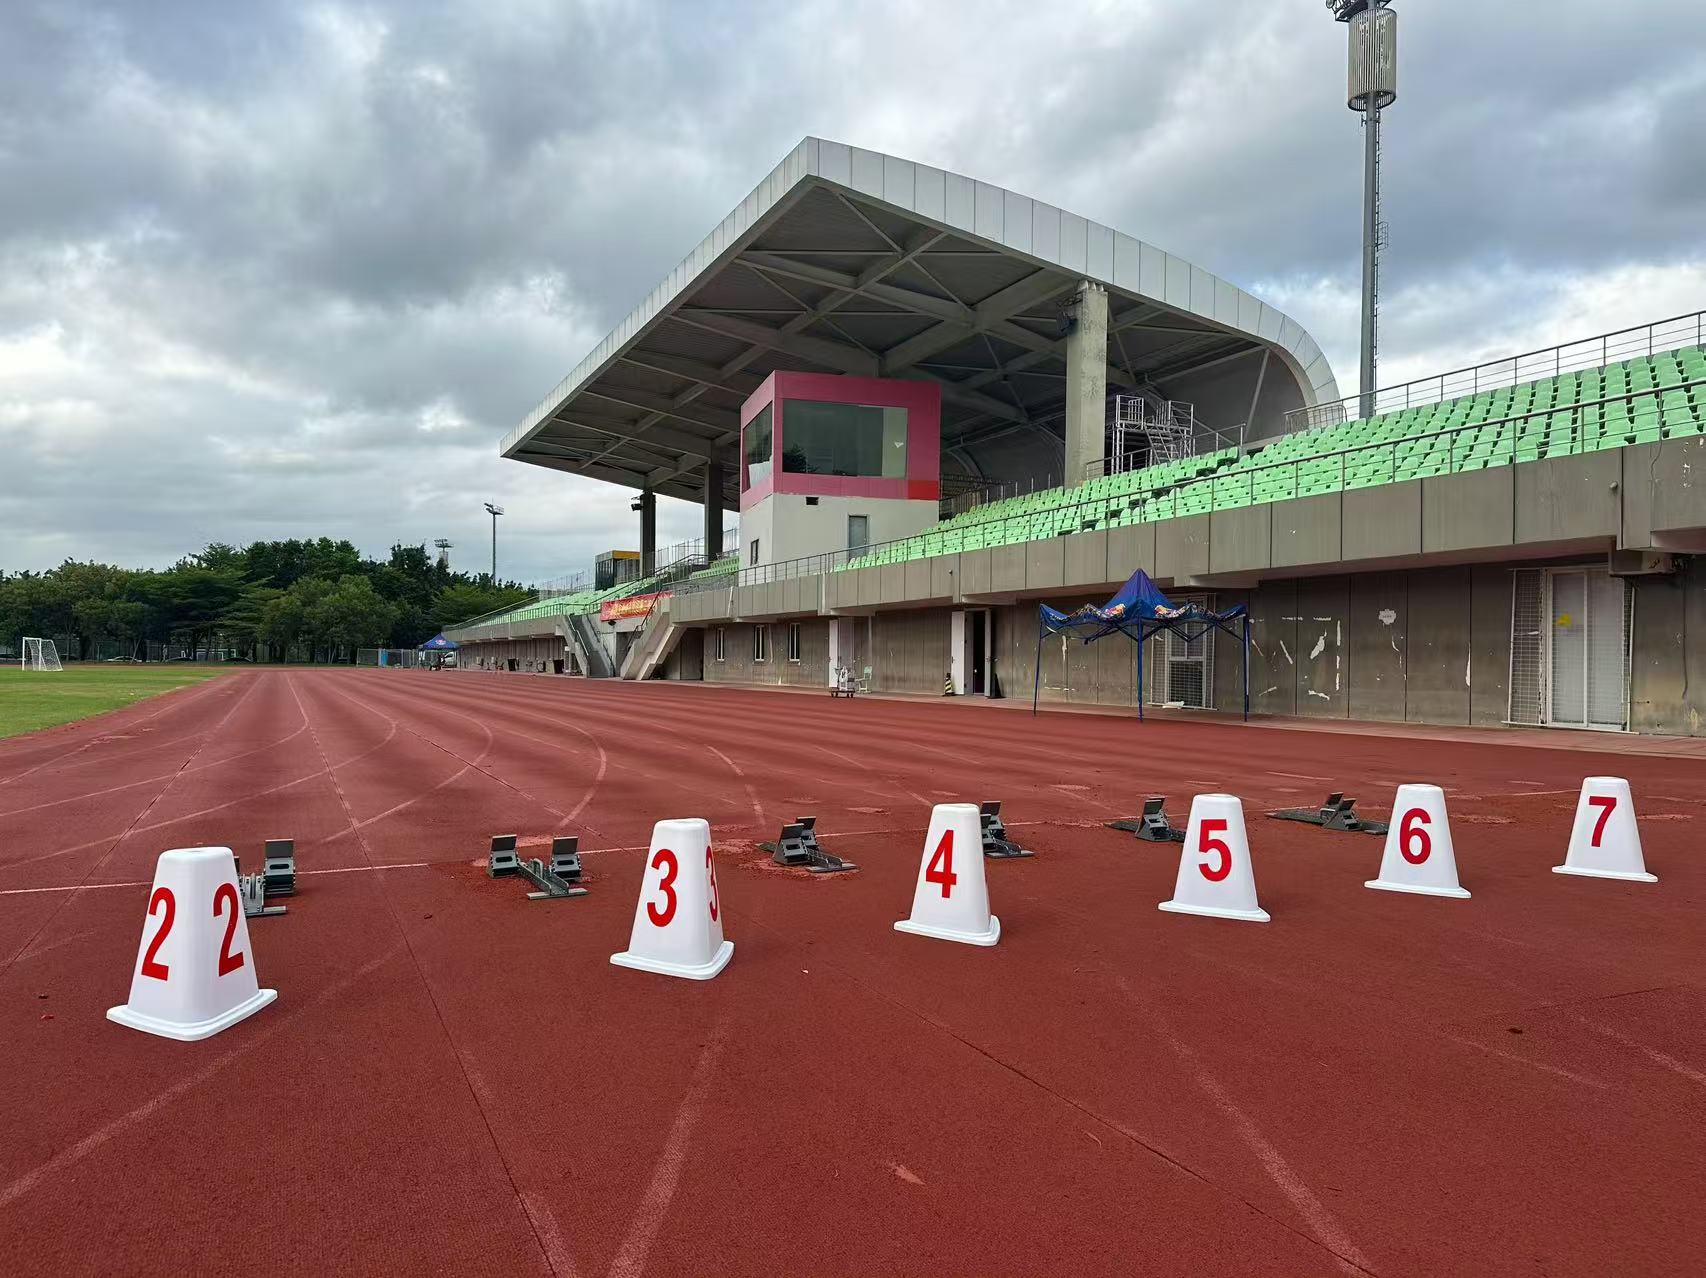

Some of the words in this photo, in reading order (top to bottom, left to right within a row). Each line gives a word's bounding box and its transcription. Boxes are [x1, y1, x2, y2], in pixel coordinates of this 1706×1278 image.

[1199, 819, 1232, 882] 5
[1399, 808, 1431, 864] 6
[1589, 796, 1616, 847] 7
[647, 849, 678, 927] 3
[706, 846, 718, 922] 3
[926, 829, 957, 898] 4
[141, 887, 175, 981] 2
[213, 883, 244, 976] 2
